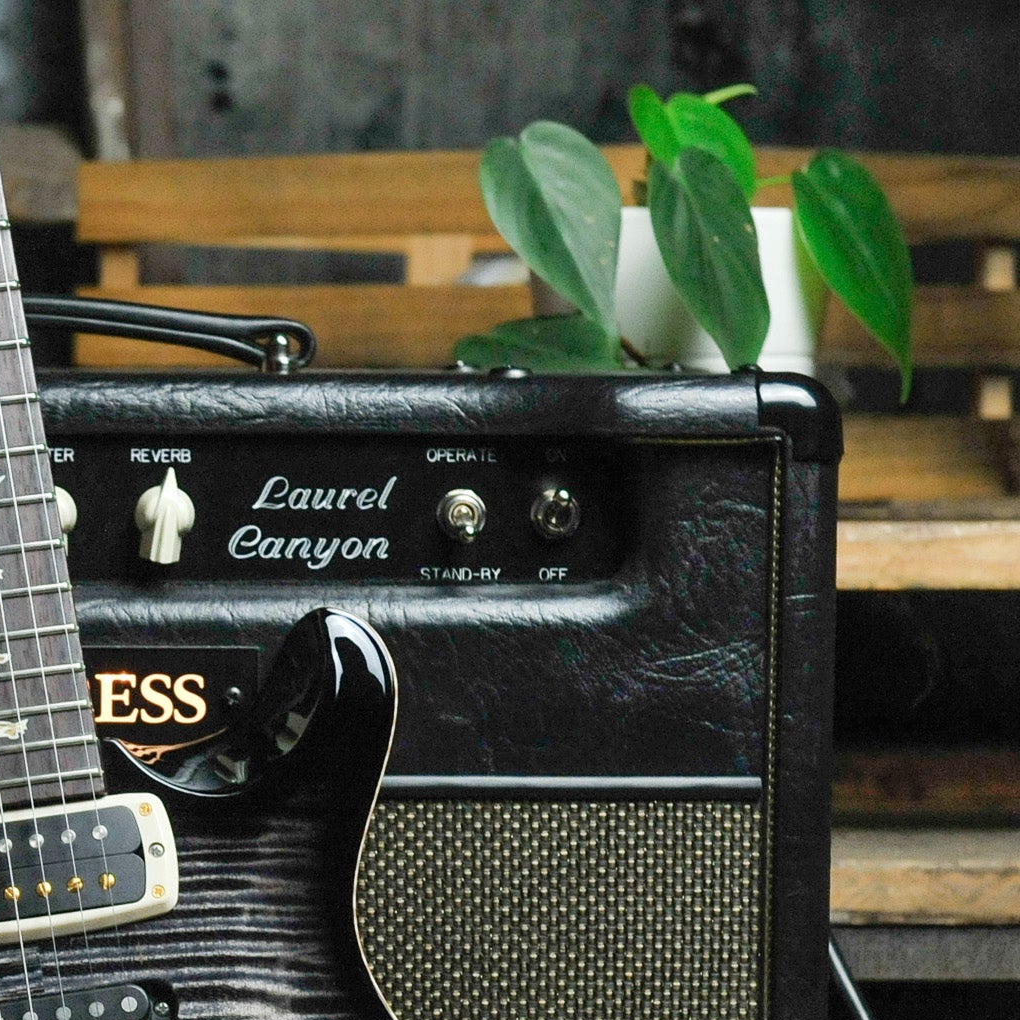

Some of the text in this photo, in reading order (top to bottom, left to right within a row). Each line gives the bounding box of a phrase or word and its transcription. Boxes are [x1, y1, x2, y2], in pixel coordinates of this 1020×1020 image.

[130, 448, 192, 463] REVERB
[426, 448, 498, 463] OPERATE
[252, 476, 398, 510] Laurel
[228, 524, 389, 570] Canyon
[420, 567, 501, 581] STAND-BY
[538, 567, 569, 581] OFF
